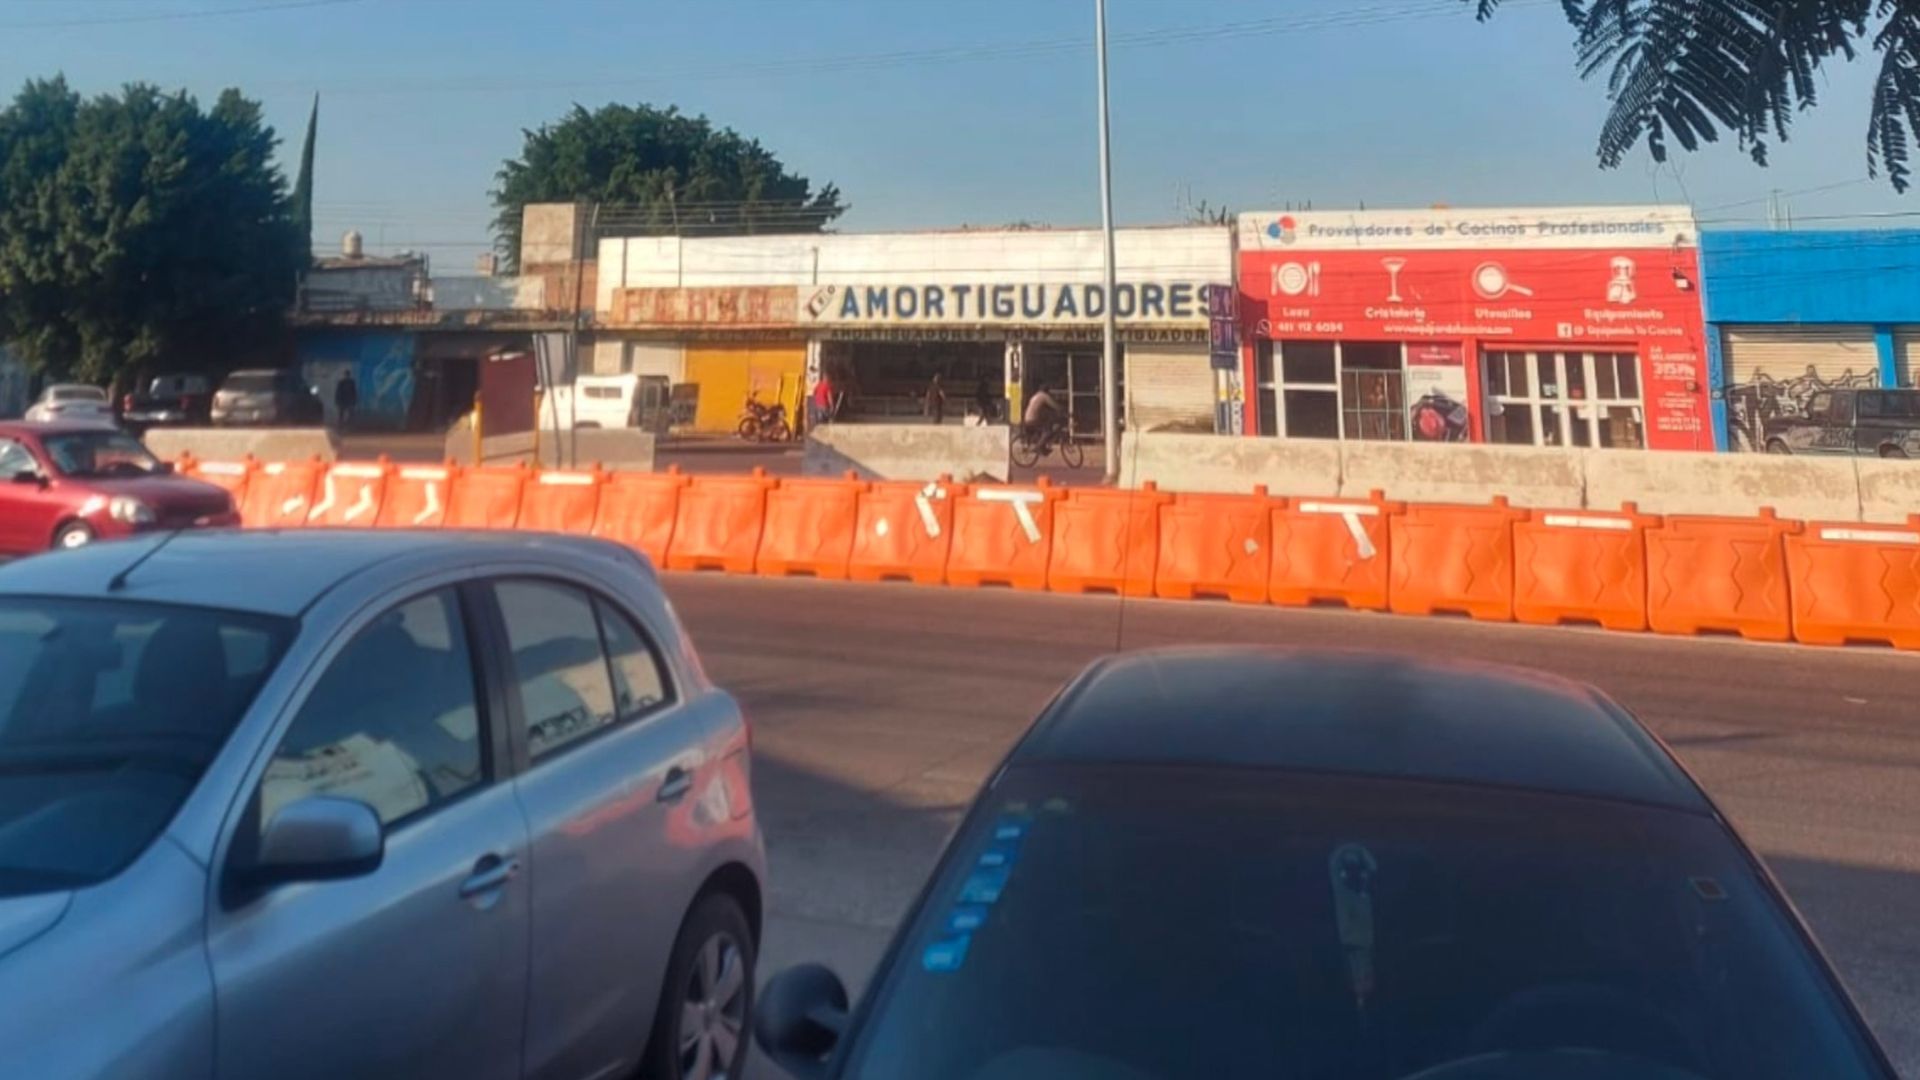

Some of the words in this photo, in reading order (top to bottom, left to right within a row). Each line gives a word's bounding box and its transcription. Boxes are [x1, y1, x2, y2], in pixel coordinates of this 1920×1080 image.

[1308, 224, 1413, 238] Proveedores
[1425, 224, 1446, 236] de
[1457, 221, 1527, 236] Cocinas
[1538, 220, 1665, 235] Profesionales
[839, 283, 1210, 319] AMORTIGUADORES
